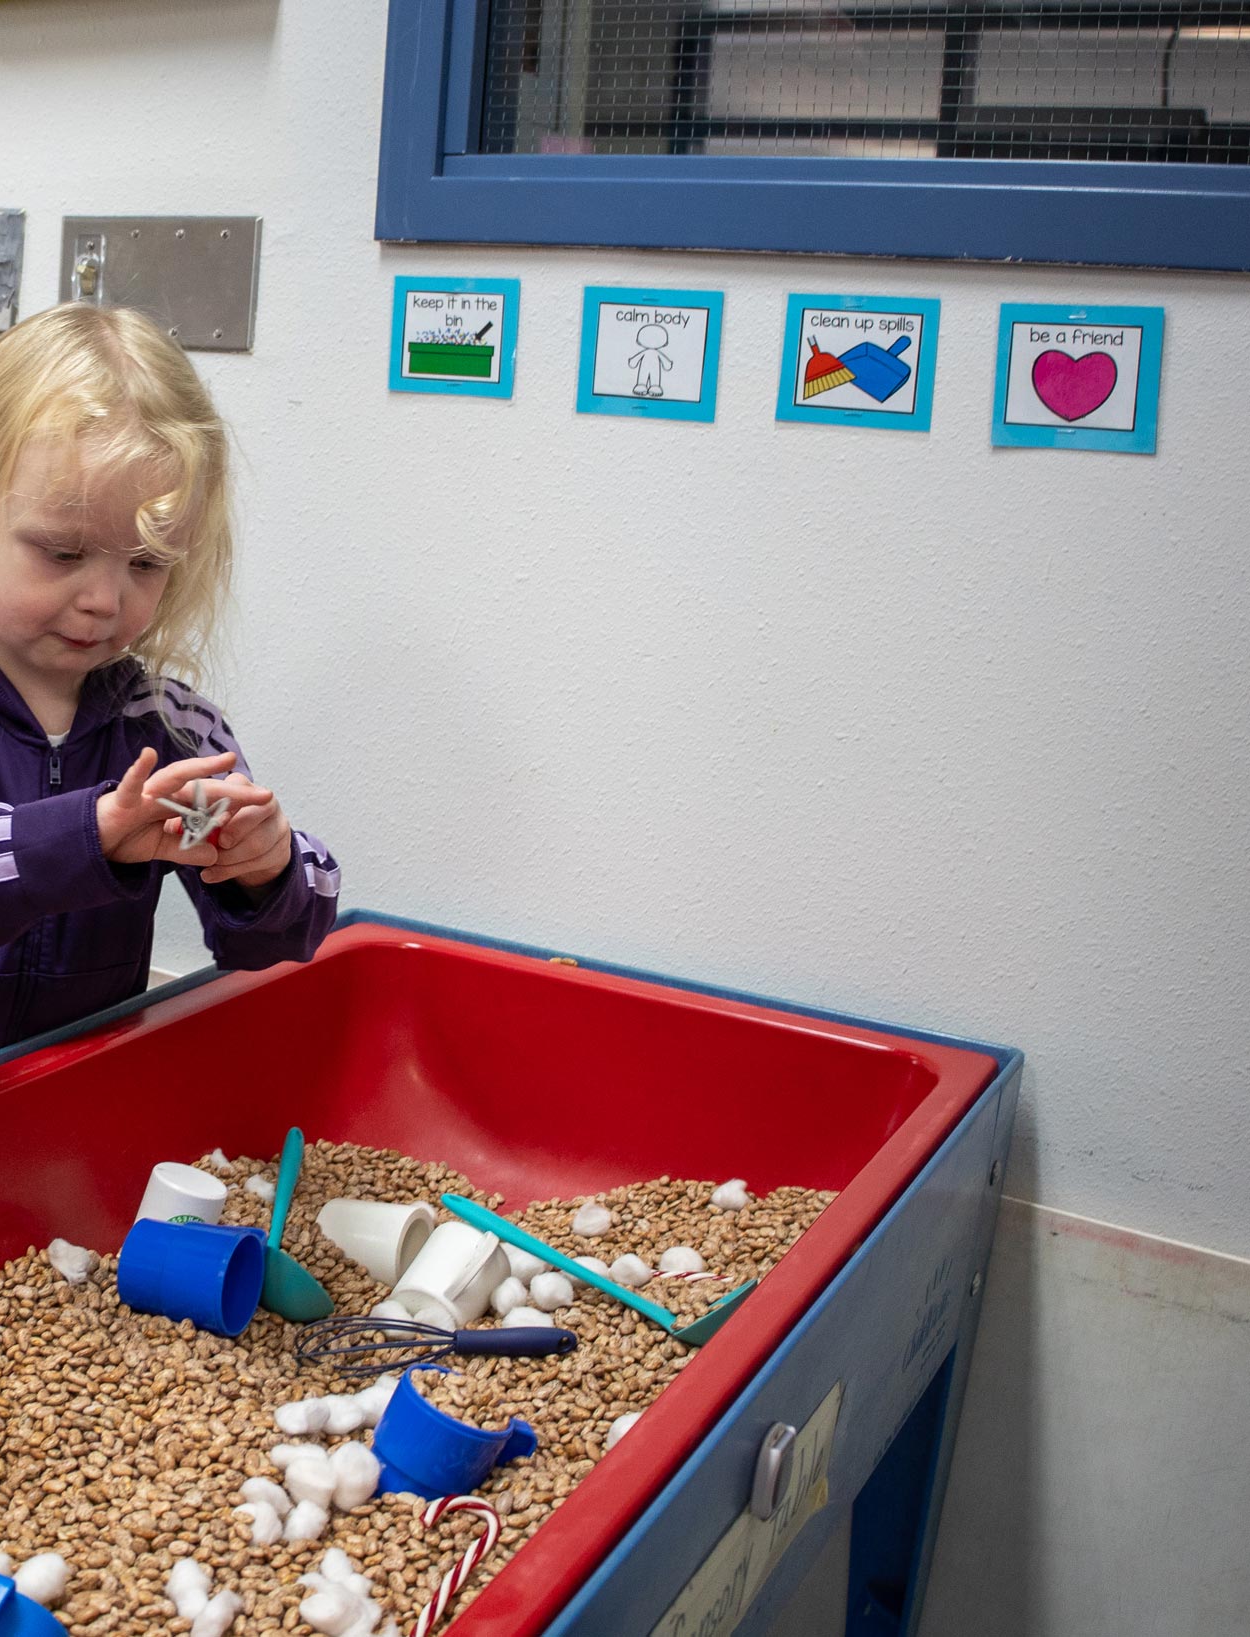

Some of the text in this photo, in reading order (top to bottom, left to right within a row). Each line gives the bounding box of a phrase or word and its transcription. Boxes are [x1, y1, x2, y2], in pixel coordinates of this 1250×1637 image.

[412, 294, 498, 312] keep it in the
[445, 313, 463, 327] bin
[615, 307, 691, 329] calm body
[810, 312, 915, 335] clean up spills
[1030, 327, 1124, 347] be a friend
